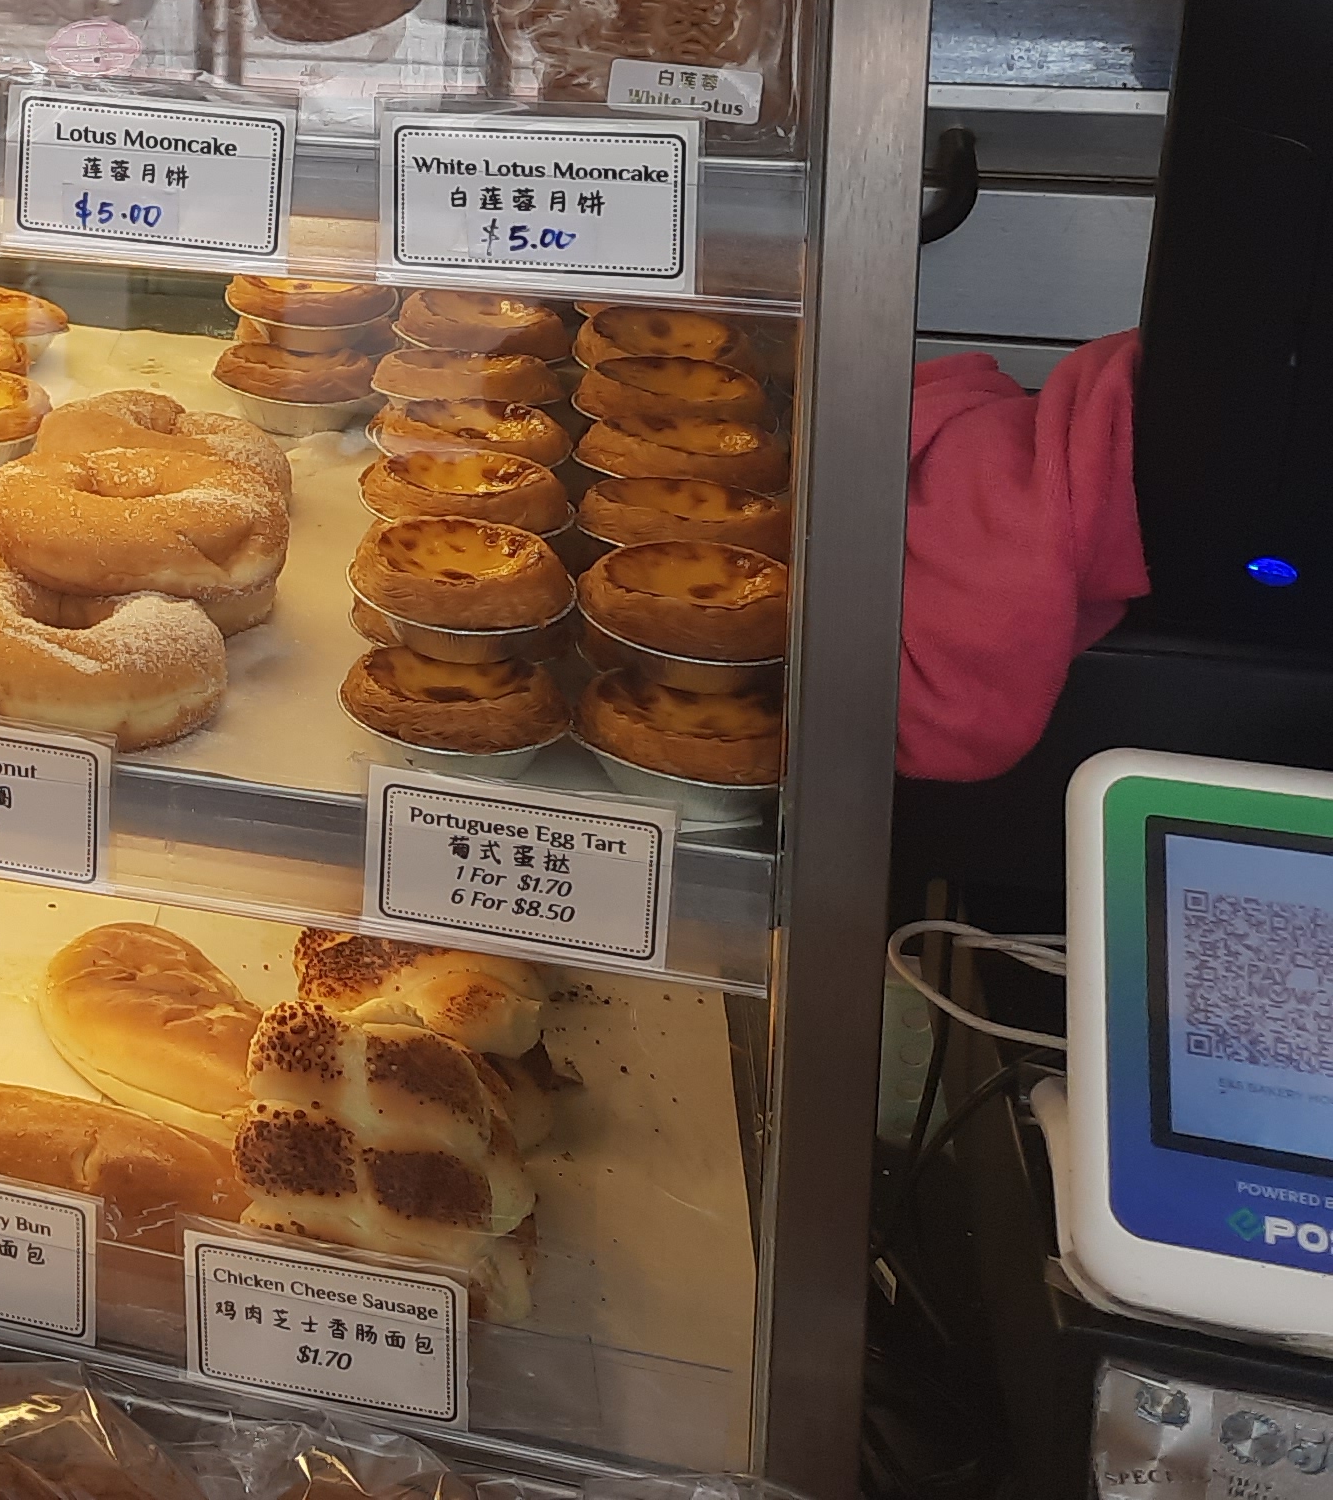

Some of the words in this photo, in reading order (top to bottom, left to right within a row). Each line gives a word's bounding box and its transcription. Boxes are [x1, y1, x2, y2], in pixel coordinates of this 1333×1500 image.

[56, 122, 116, 145] Lotus
[124, 129, 237, 156] Mooncake
[82, 157, 189, 189] 莲蓉月饼
[413, 156, 477, 176] White
[484, 159, 545, 178] Lotus
[554, 162, 669, 182] Mooncake
[450, 186, 605, 216] 白莲蓉月饼
[409, 806, 529, 838] Portuguese
[536, 825, 574, 850] Egg
[582, 833, 627, 854] Tart
[470, 867, 507, 886] For
[517, 875, 572, 897] $1.70
[451, 889, 463, 904] 6
[471, 891, 508, 911] For
[512, 899, 575, 922] $8.50
[1236, 1180, 1319, 1206] POWERED
[16, 1216, 51, 1237] Bun
[213, 1268, 284, 1292] Chicken
[291, 1281, 358, 1305] Cheese
[363, 1293, 438, 1320] Sausage
[216, 1301, 434, 1355] 鸡肉芝士香肠面包
[297, 1345, 352, 1370] $1.70
